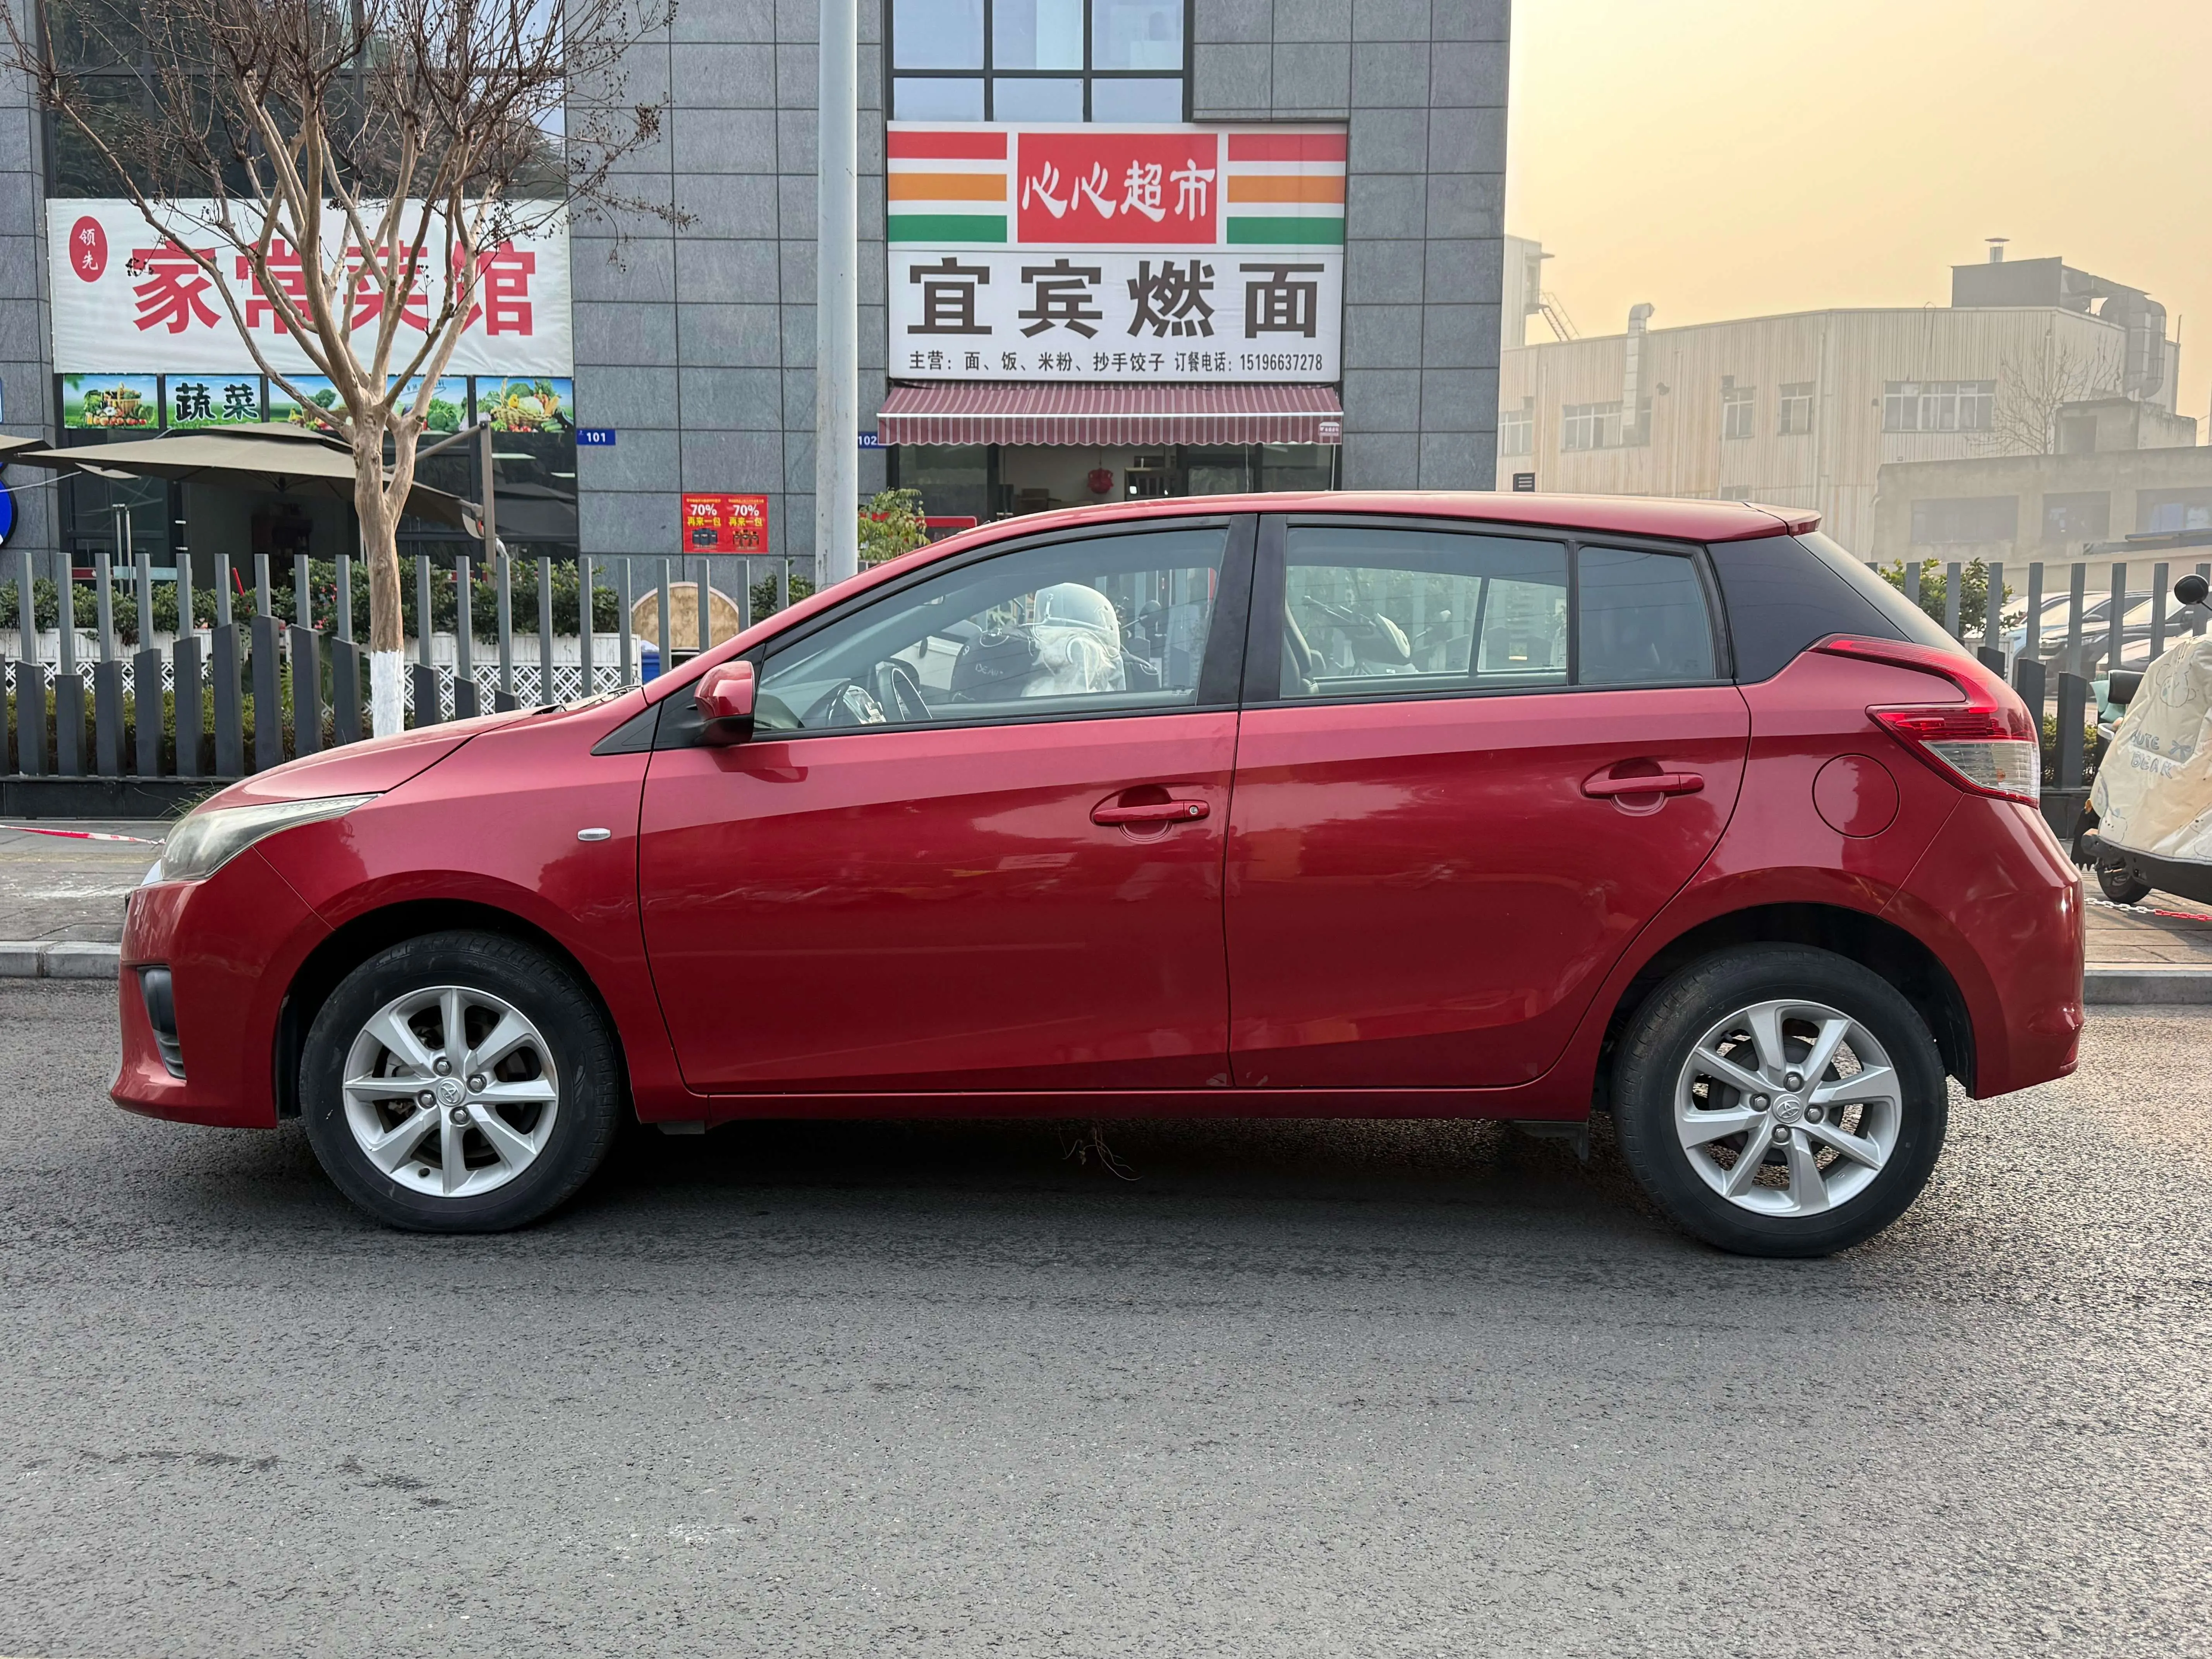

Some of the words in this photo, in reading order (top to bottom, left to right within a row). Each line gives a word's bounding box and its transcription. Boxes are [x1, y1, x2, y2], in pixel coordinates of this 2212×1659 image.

[1022, 158, 1216, 222] 心心超市
[79, 228, 99, 270] 领先
[132, 239, 536, 336] 家常菜馆
[907, 257, 1325, 339] 宜宾燃面
[175, 382, 259, 422] 蔬菜
[587, 432, 605, 443] 101
[858, 435, 877, 445] 102
[690, 503, 718, 516] 70%
[733, 504, 759, 516] 70%
[2131, 751, 2172, 779] BEAR
